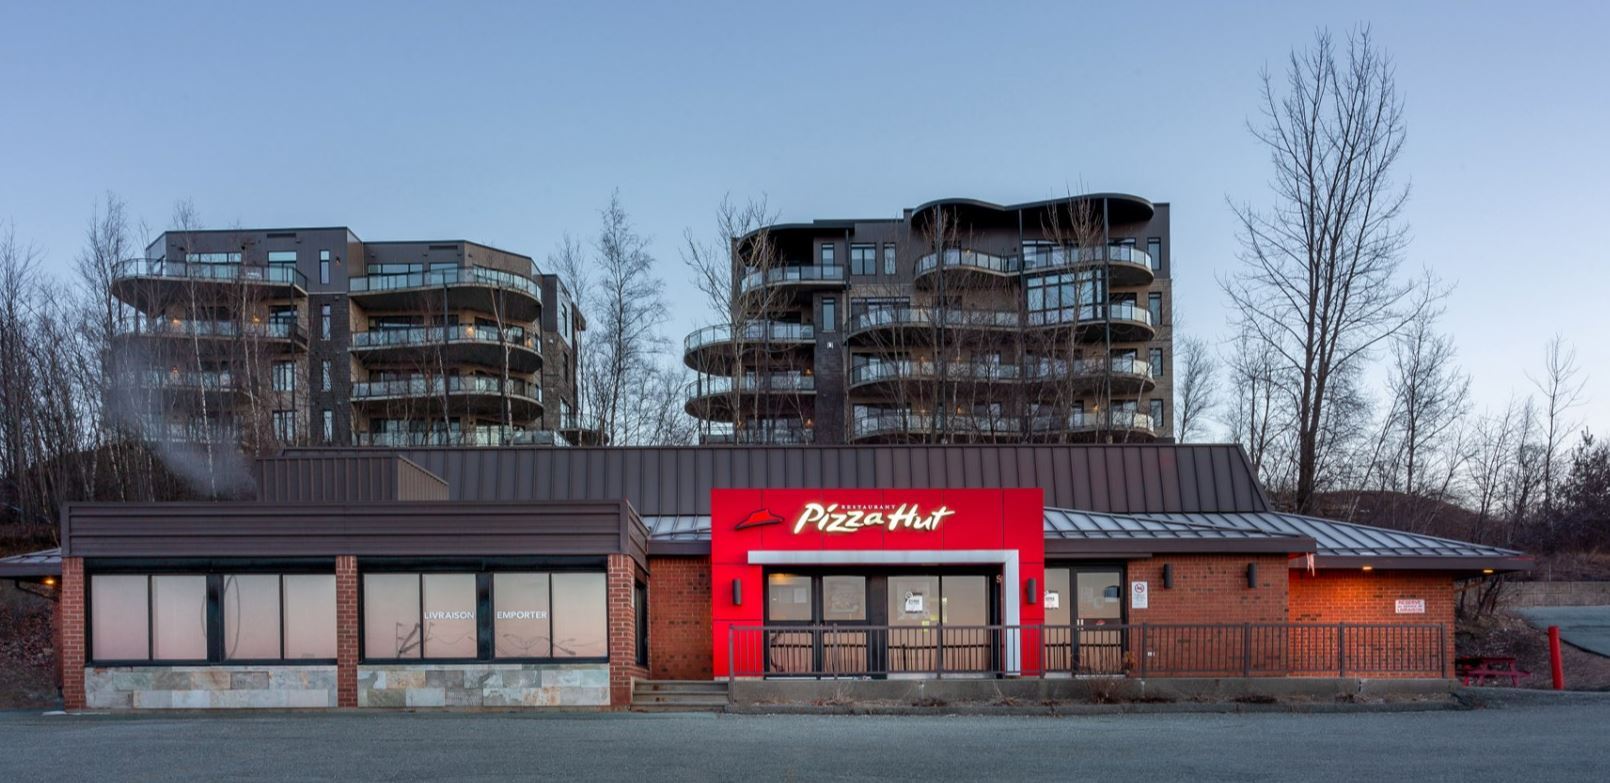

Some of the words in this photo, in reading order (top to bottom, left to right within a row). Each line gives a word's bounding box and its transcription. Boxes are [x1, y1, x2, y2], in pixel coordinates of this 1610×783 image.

[793, 503, 884, 534] Pizza
[887, 503, 956, 531] Hut
[424, 611, 474, 619] LIVRAISON
[497, 611, 547, 619] EMPORTER
